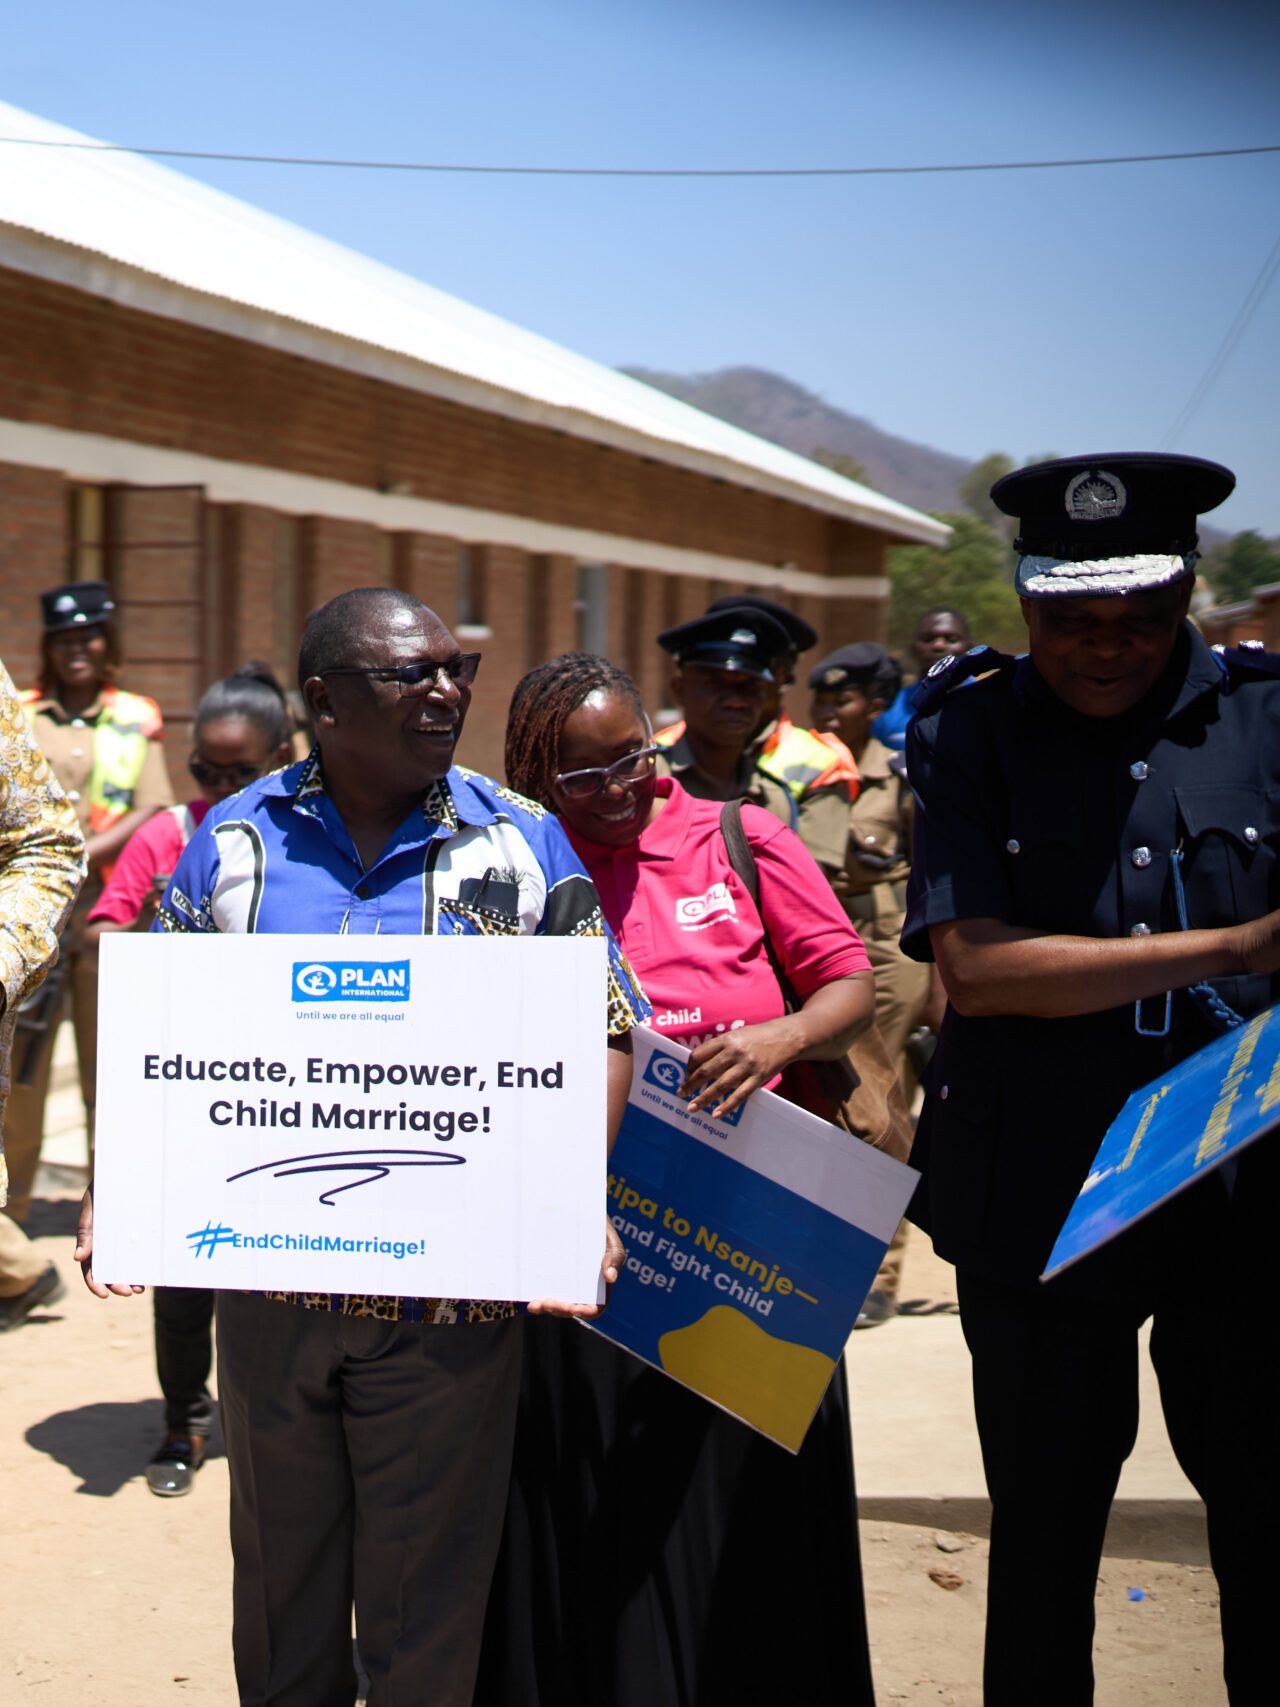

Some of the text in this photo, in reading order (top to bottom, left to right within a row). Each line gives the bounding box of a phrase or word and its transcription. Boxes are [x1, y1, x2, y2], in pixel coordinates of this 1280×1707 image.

[341, 968, 405, 987] PLAN
[341, 988, 405, 997] INTERNATIONAL
[296, 1011, 320, 1020] Until
[322, 1012, 338, 1020] we
[359, 1012, 373, 1021] all
[374, 1013, 405, 1023] equal
[656, 1007, 702, 1027] child
[144, 1054, 564, 1093] Educate, Empower, End
[209, 1100, 491, 1142] Child Marriage!
[641, 1088, 662, 1105] Until
[662, 1101, 675, 1112] we
[675, 1107, 689, 1119] are
[690, 1114, 703, 1127] all
[703, 1122, 728, 1141] equal
[606, 1174, 659, 1219] tipa
[663, 1207, 691, 1237] to
[186, 1220, 425, 1260] #EndChildMarriage!
[611, 1215, 774, 1317] and Fight Child
[623, 1248, 677, 1293] iage!
